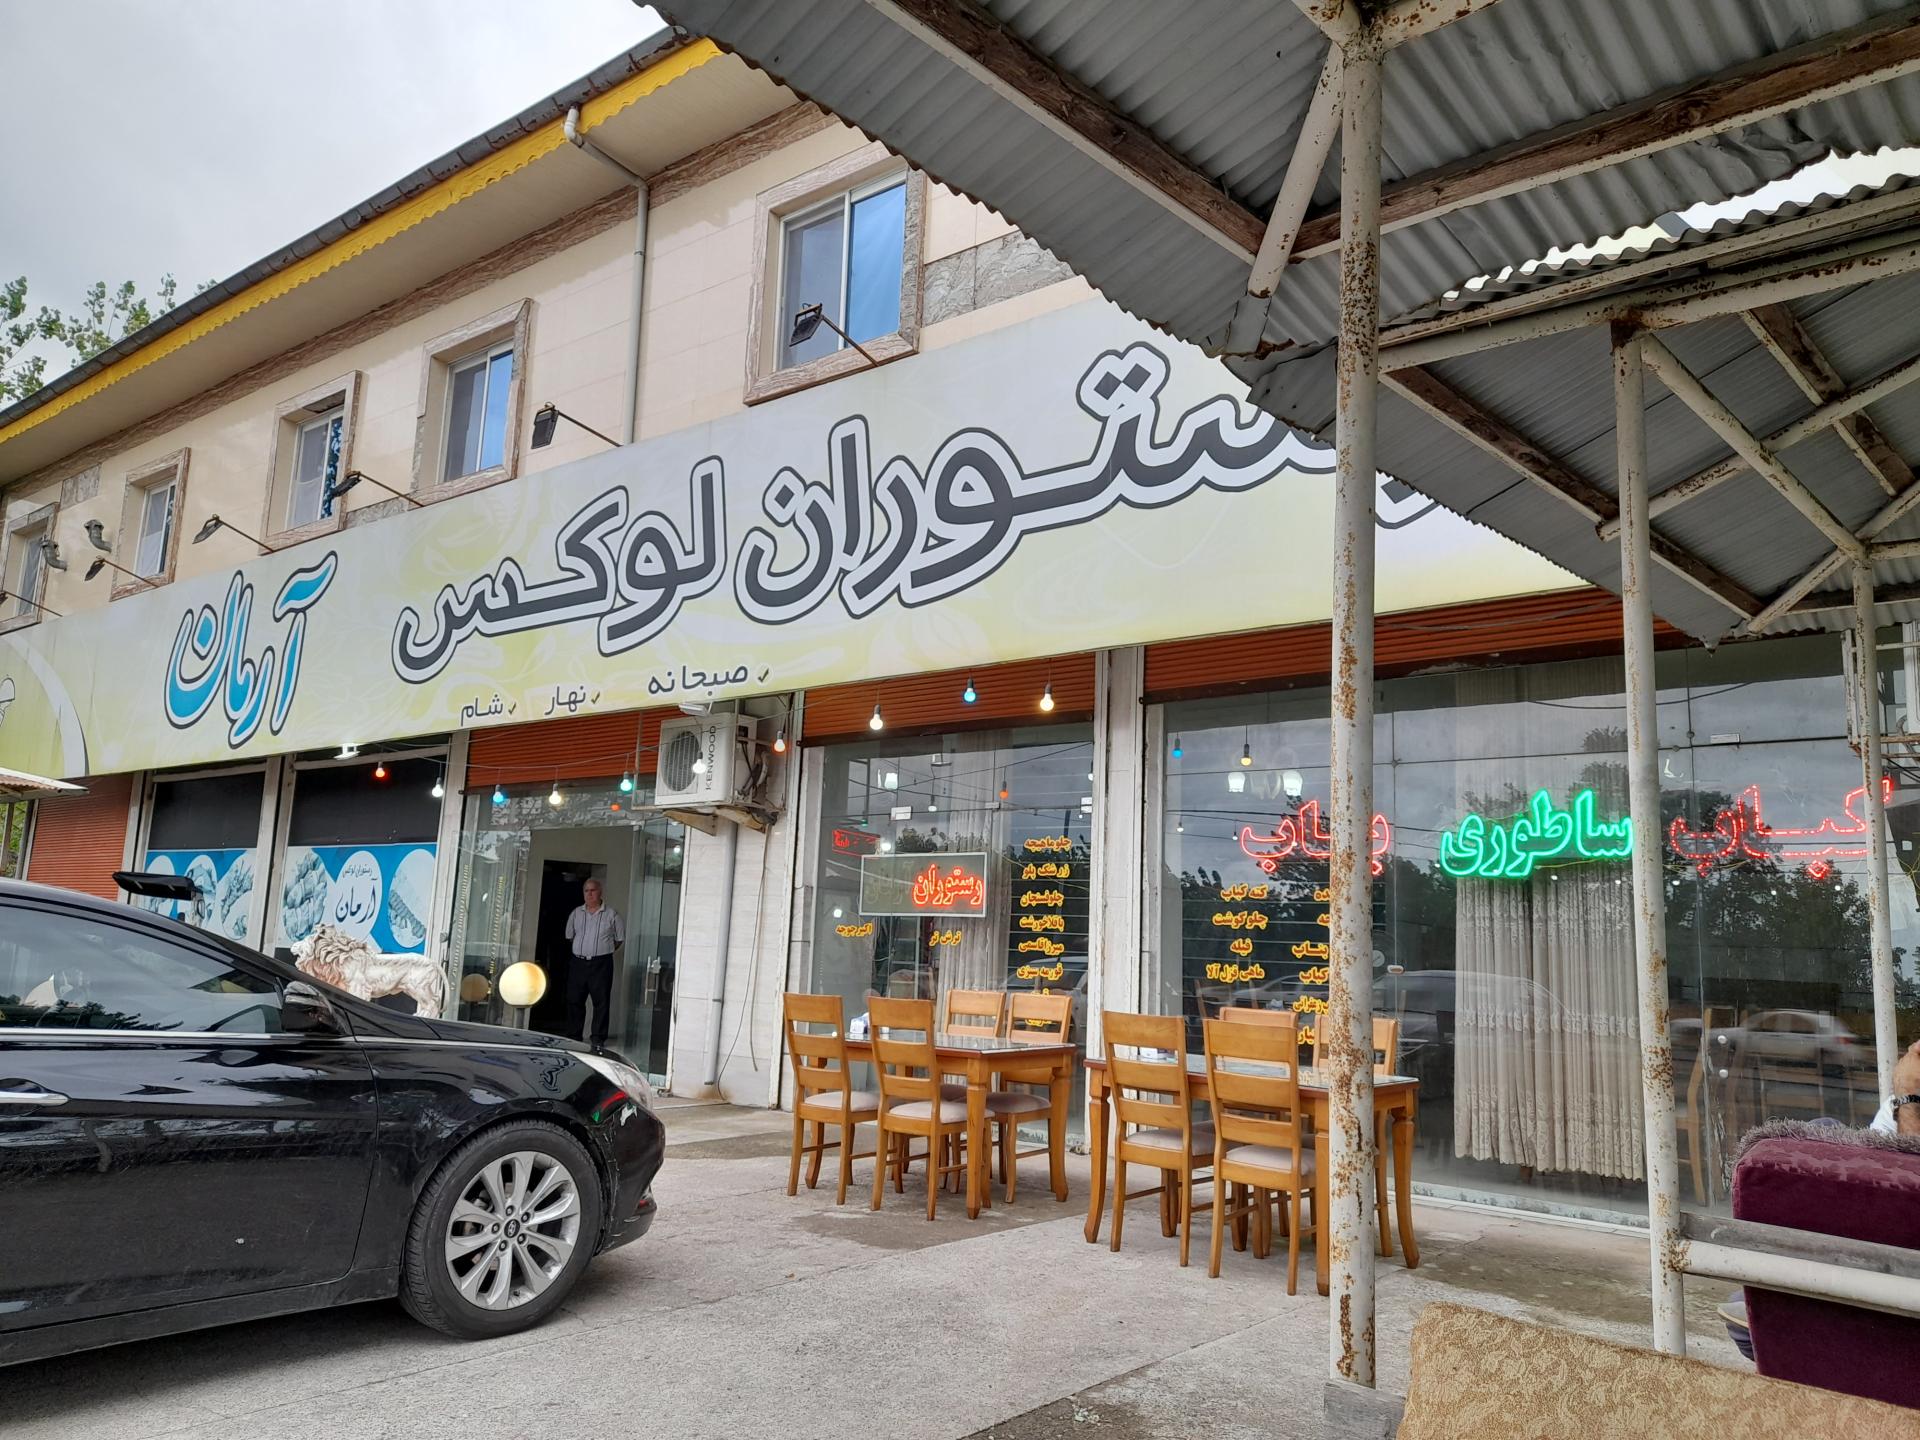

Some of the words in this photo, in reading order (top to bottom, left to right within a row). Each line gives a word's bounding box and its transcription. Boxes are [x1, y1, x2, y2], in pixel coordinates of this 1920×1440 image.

[735, 341, 1440, 626] ستوران
[392, 454, 727, 684] لوکس
[163, 550, 339, 749] آرمان
[545, 686, 586, 716] نهار
[648, 663, 749, 697] صبحانه
[460, 694, 503, 727] شام
[705, 725, 717, 791] KENWOOD
[1440, 788, 1636, 879] ساطوری
[335, 877, 378, 925] آرمان
[913, 863, 983, 905] رستوران
